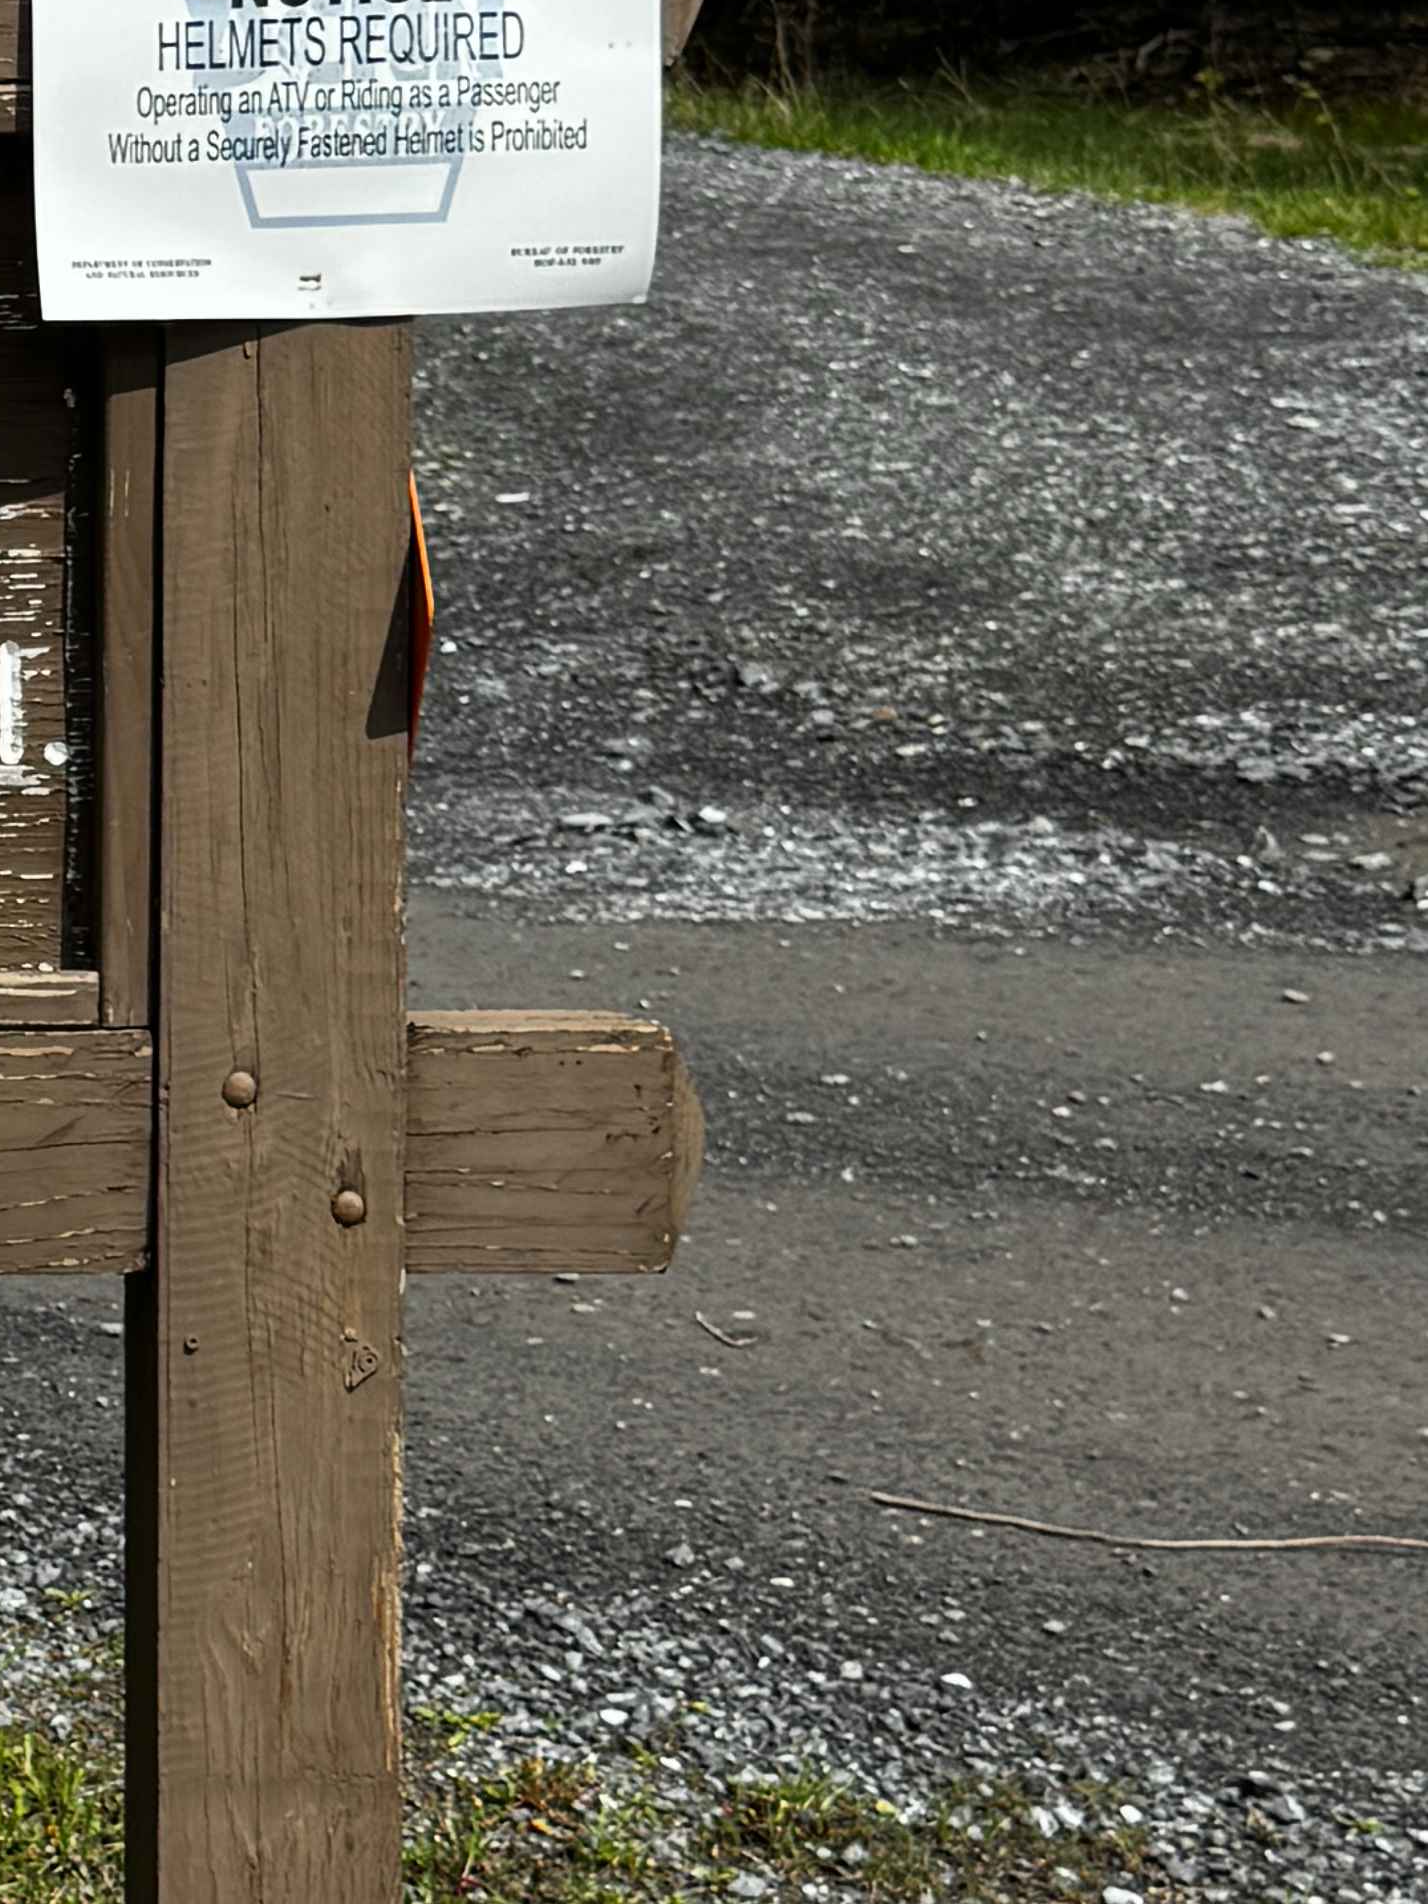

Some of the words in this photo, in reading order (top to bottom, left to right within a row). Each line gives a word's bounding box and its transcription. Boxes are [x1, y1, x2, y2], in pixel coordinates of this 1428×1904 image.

[157, 16, 327, 72] HELMETS
[338, 11, 526, 65] REQUIRED
[136, 83, 233, 125] Operating
[238, 89, 263, 115] an
[268, 80, 311, 113] ATV
[314, 87, 335, 112] or
[341, 78, 402, 117] Riding
[409, 84, 433, 109] as
[438, 83, 452, 108] a
[457, 76, 561, 114] Passenger
[107, 130, 183, 165] Without
[188, 138, 200, 162] a
[206, 129, 293, 168] Securely
[297, 124, 388, 159] Fastened
[394, 122, 465, 156] Helmet
[469, 120, 484, 153] is
[491, 117, 588, 152] Prohibited
